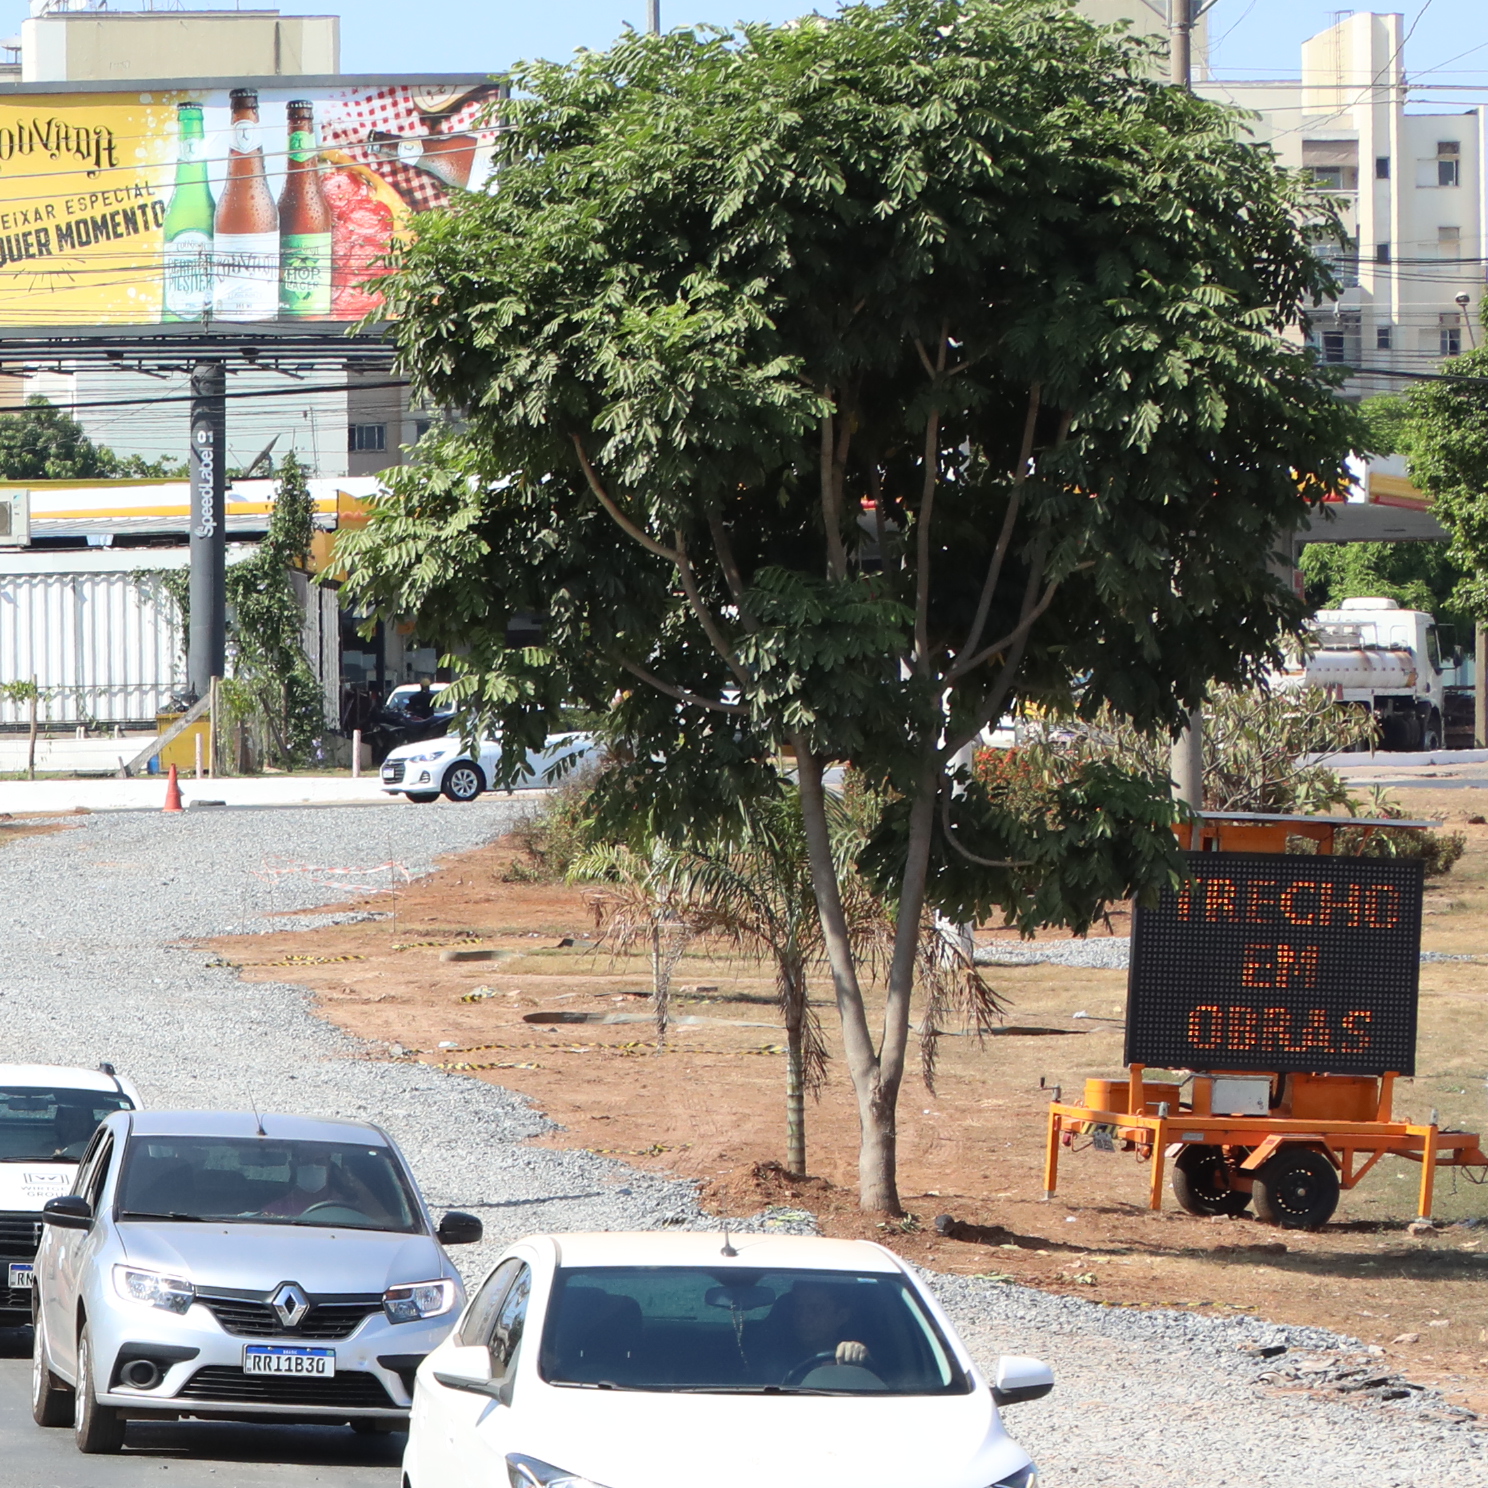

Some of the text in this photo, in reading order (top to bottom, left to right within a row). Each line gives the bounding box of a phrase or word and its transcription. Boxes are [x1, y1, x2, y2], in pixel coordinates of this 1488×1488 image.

[55, 199, 166, 253] MOMENTO
[286, 266, 321, 280] HOP
[194, 447, 218, 538] SpeedLabel
[1176, 877, 1401, 930] TRECHO
[1242, 944, 1320, 988] EM
[1187, 1004, 1373, 1054] OBRAS
[252, 1355, 326, 1374] RRI1B30
